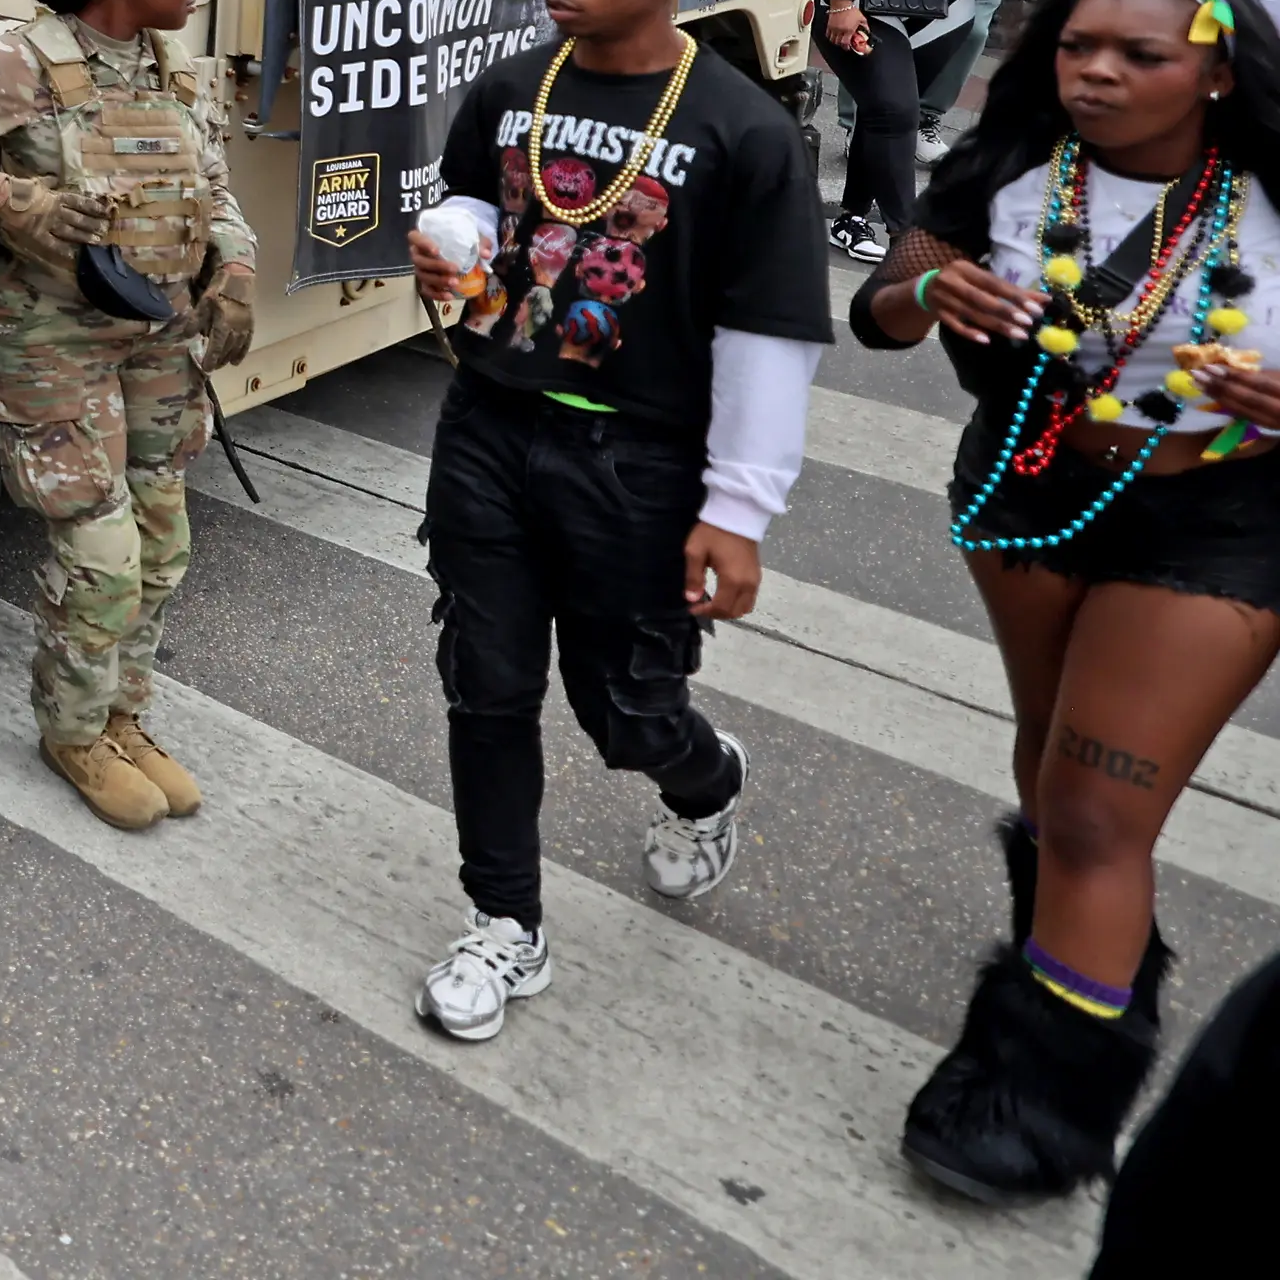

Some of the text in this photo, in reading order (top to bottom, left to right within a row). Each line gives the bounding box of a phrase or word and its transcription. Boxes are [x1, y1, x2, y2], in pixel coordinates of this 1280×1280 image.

[309, 25, 536, 117] SIDE BEGINS
[326, 159, 363, 172] LOUISIANA
[318, 172, 369, 194] ARMY
[317, 189, 370, 205] NATIONAL
[400, 193, 422, 213] IS
[316, 200, 370, 221] GUARD
